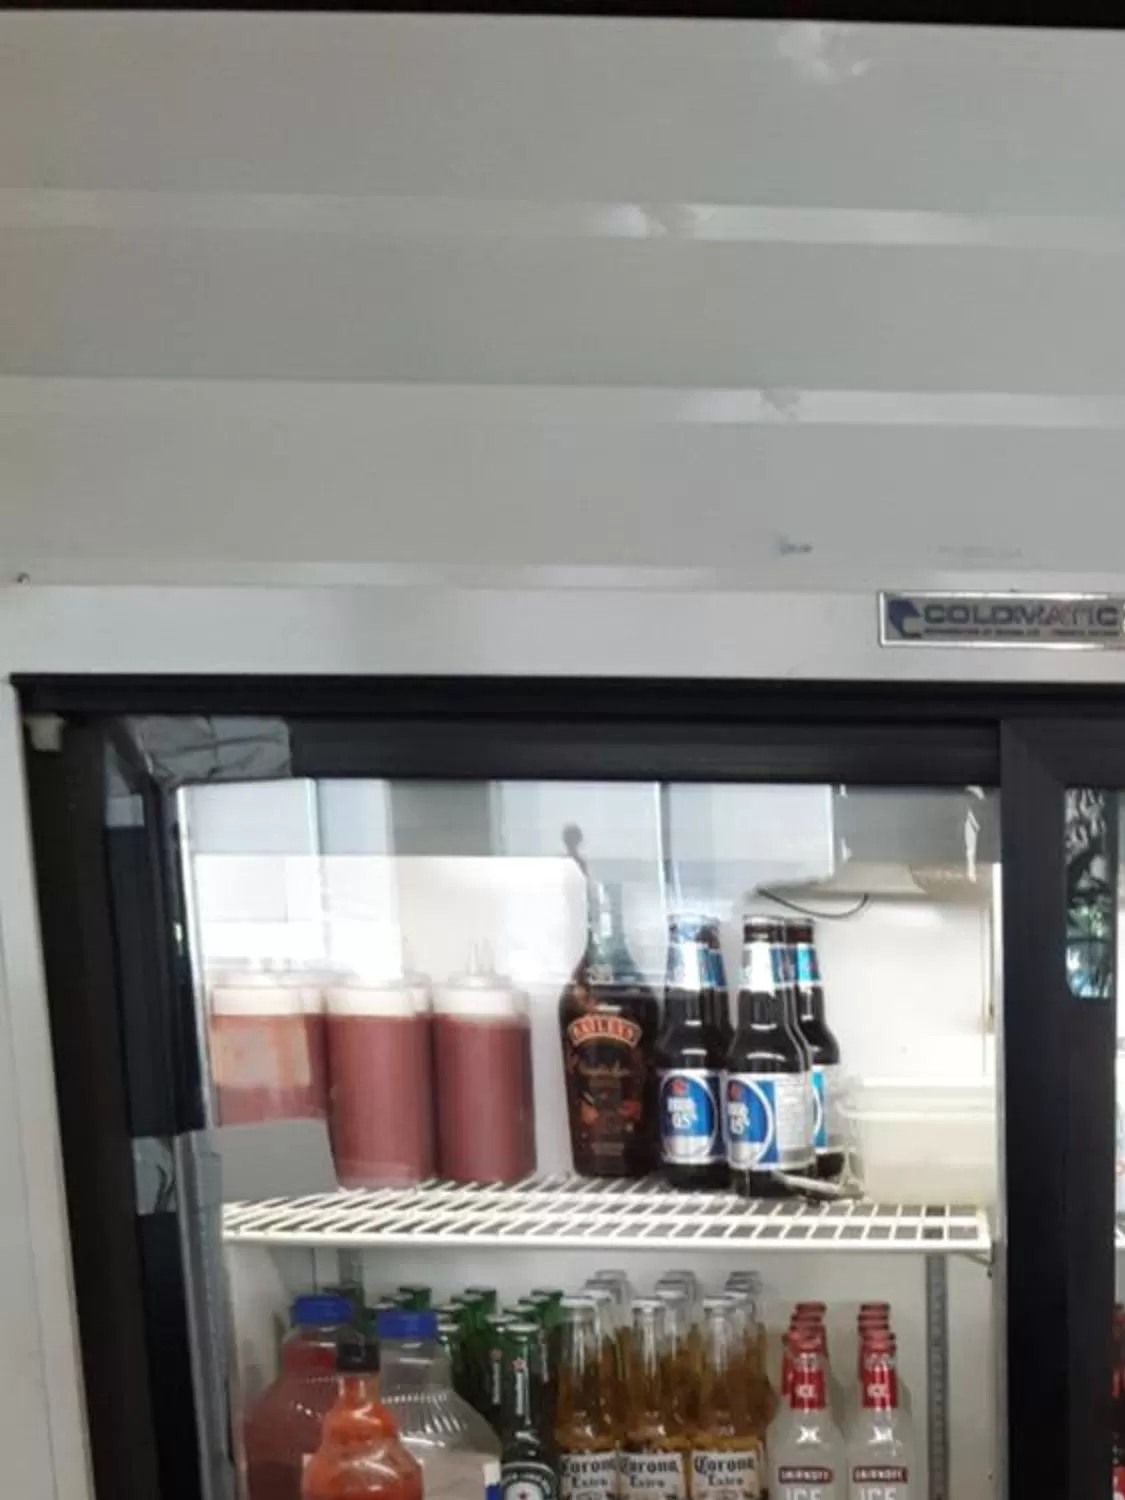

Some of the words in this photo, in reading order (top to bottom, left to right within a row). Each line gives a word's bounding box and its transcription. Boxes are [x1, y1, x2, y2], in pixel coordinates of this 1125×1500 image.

[923, 603, 1118, 627] COLDMATIC
[694, 1455, 755, 1475] Corona
[781, 1468, 830, 1482] SMIRNOFF
[855, 1468, 904, 1482] SMIRNOFF
